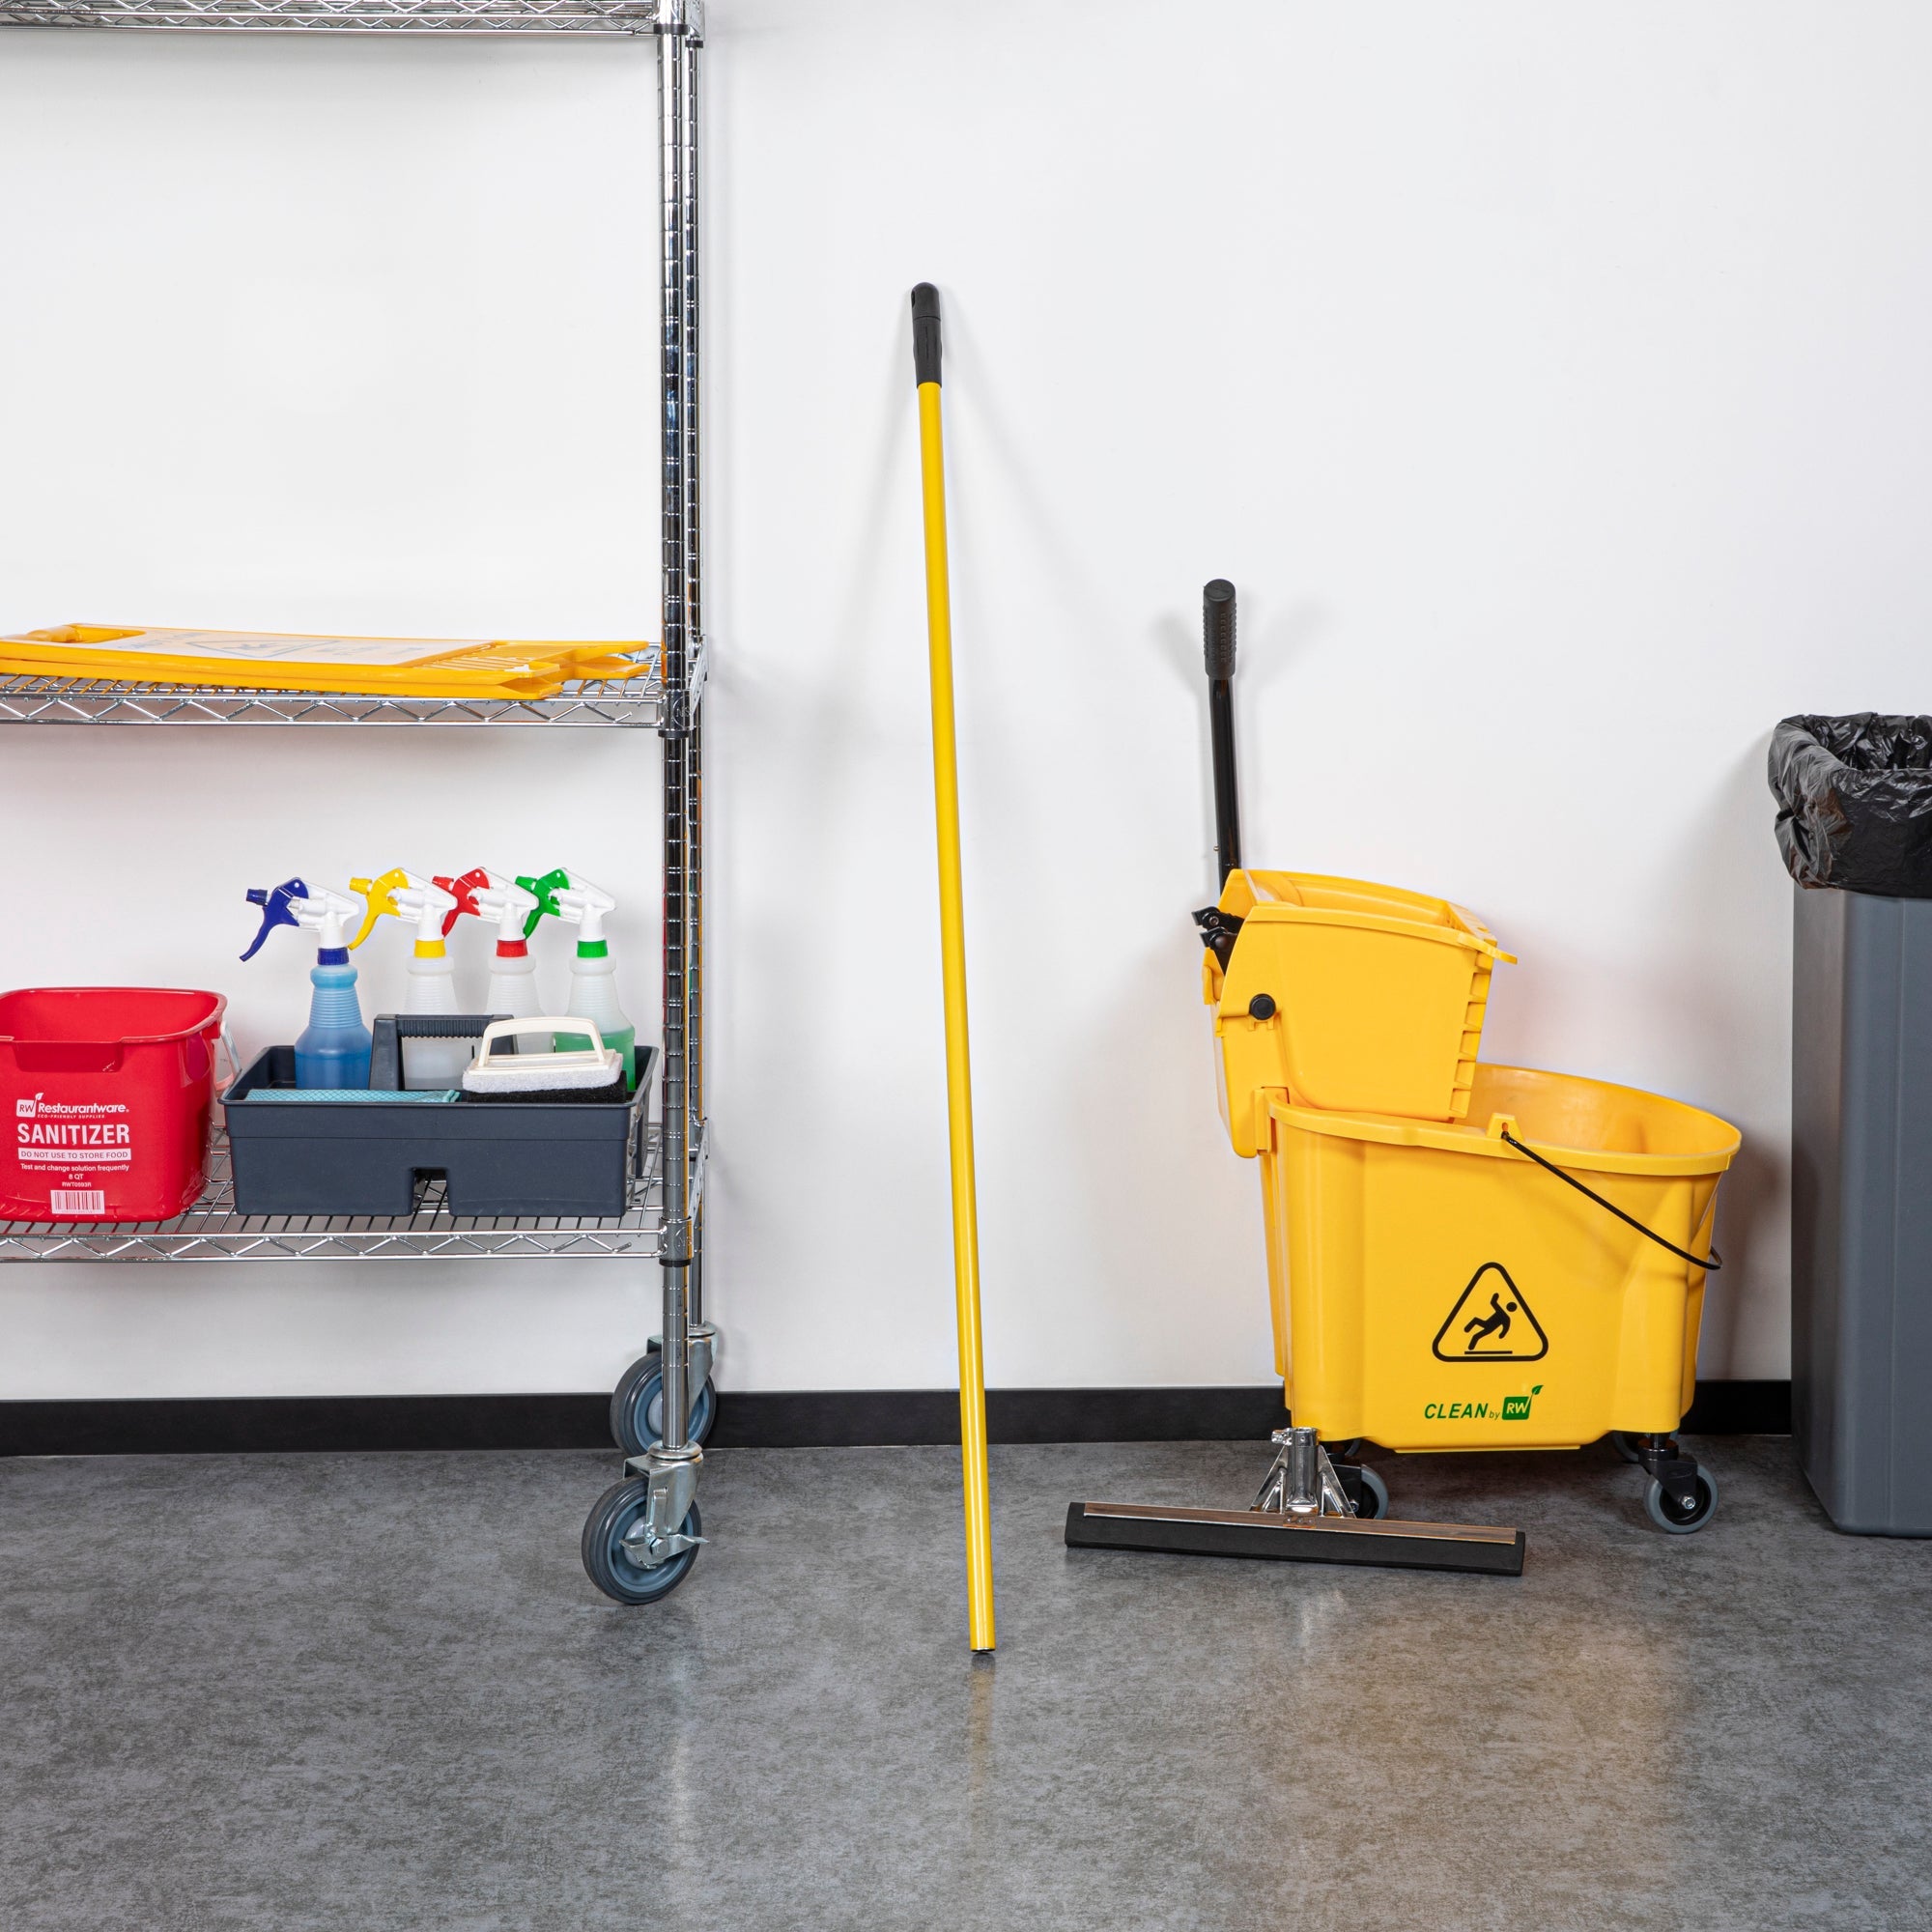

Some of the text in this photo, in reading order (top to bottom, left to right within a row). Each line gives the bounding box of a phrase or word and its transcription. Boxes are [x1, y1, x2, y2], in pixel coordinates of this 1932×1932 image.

[17, 1123, 129, 1144] SANITIZER
[47, 1164, 71, 1173] change
[98, 1164, 129, 1173] frequently
[1425, 1404, 1488, 1419] CLEAN
[1489, 1411, 1501, 1421] by
